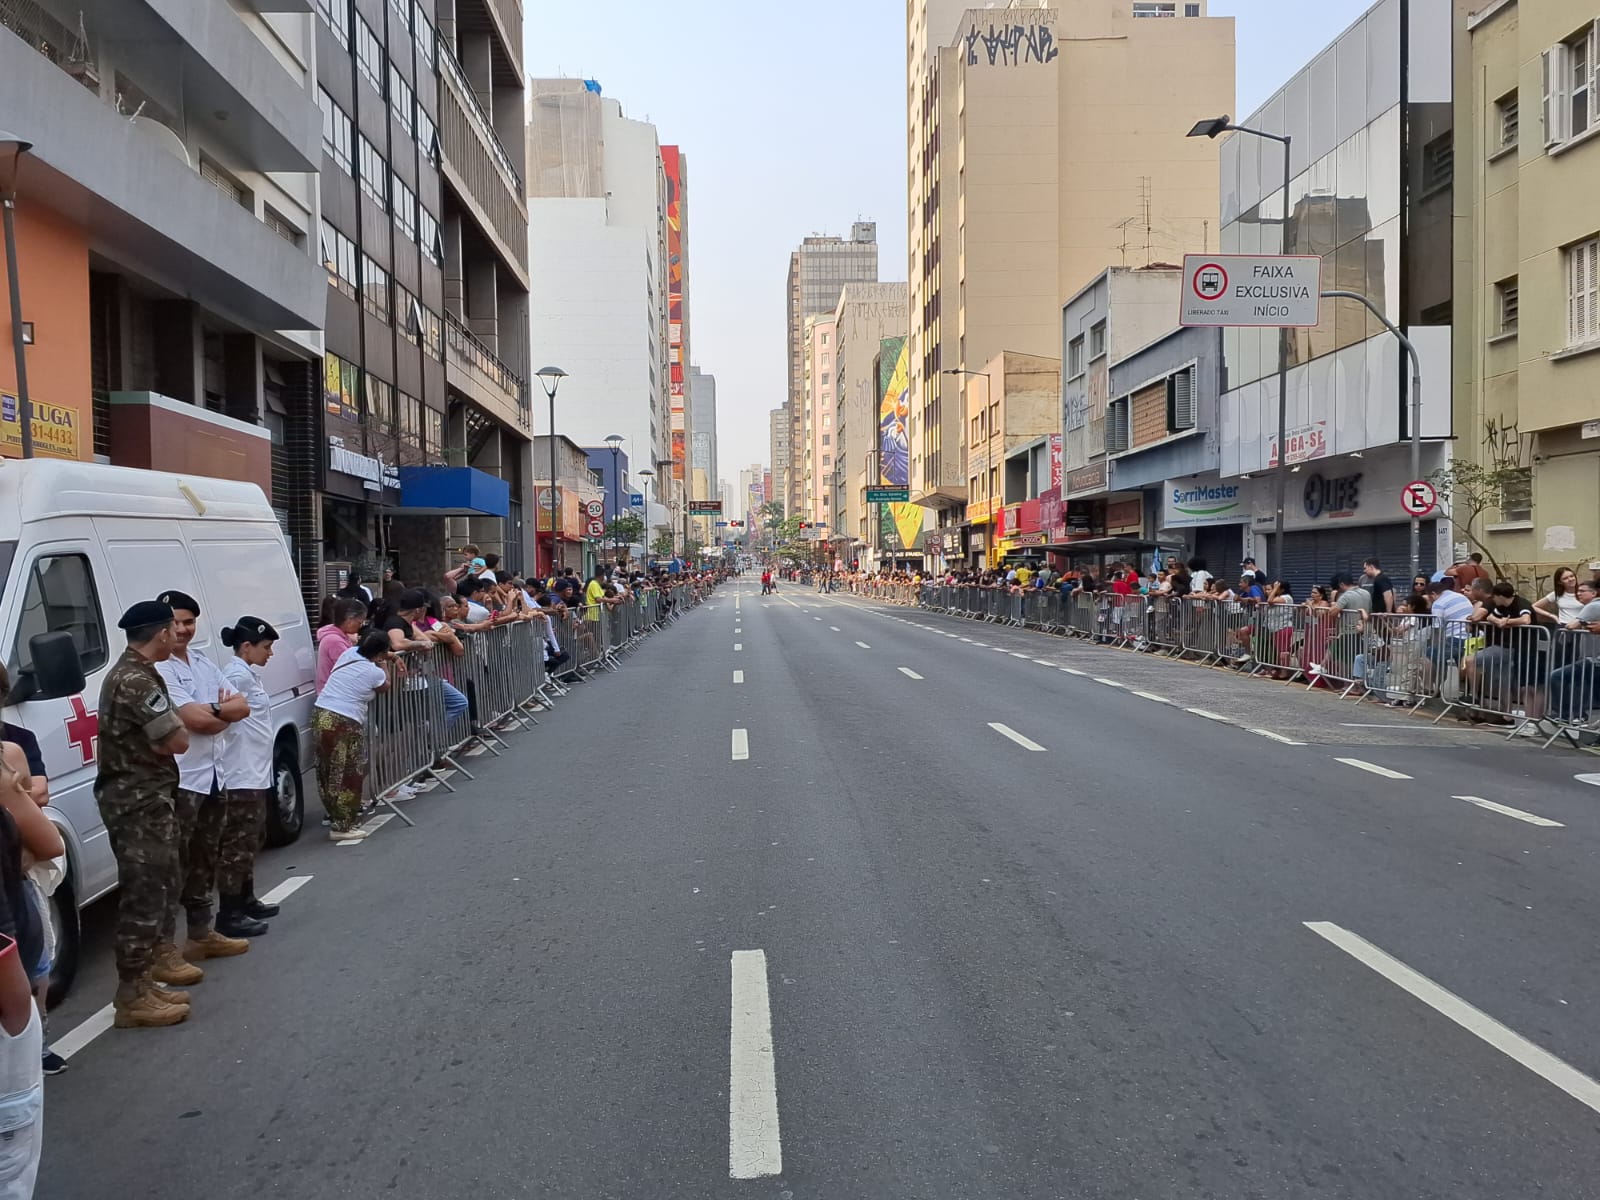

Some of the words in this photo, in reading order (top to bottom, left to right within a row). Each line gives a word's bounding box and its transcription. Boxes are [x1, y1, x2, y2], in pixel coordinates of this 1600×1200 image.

[1253, 266, 1294, 278] FAIXA
[1235, 286, 1310, 298] EXCLUSIVA
[1253, 304, 1289, 317] INÍCIO
[18, 402, 72, 428] LUGA
[1271, 430, 1323, 458] AUGA-SE
[1173, 484, 1239, 504] SorriMaster
[589, 504, 601, 513] 50
